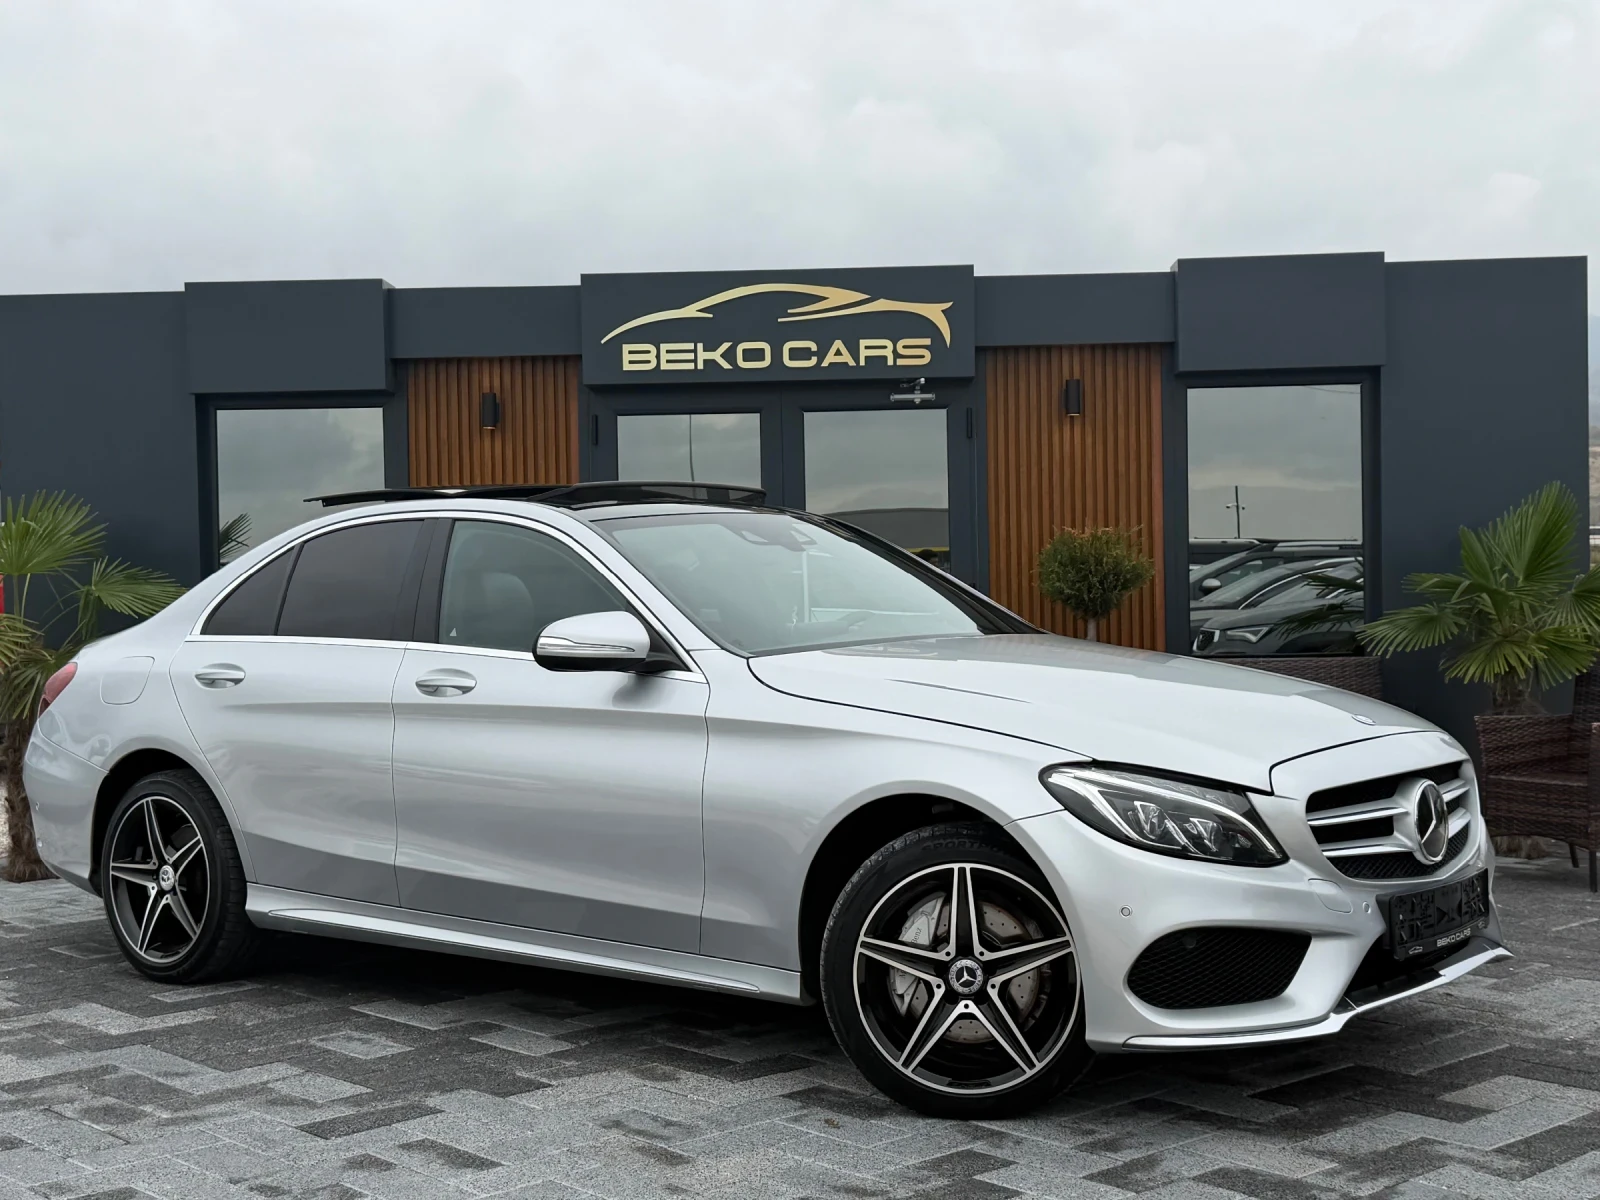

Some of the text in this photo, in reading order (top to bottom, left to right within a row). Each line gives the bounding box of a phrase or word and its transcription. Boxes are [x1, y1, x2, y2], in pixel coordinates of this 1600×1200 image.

[621, 338, 932, 371] BEKO CARS
[1436, 927, 1471, 947] BEKO CARS
